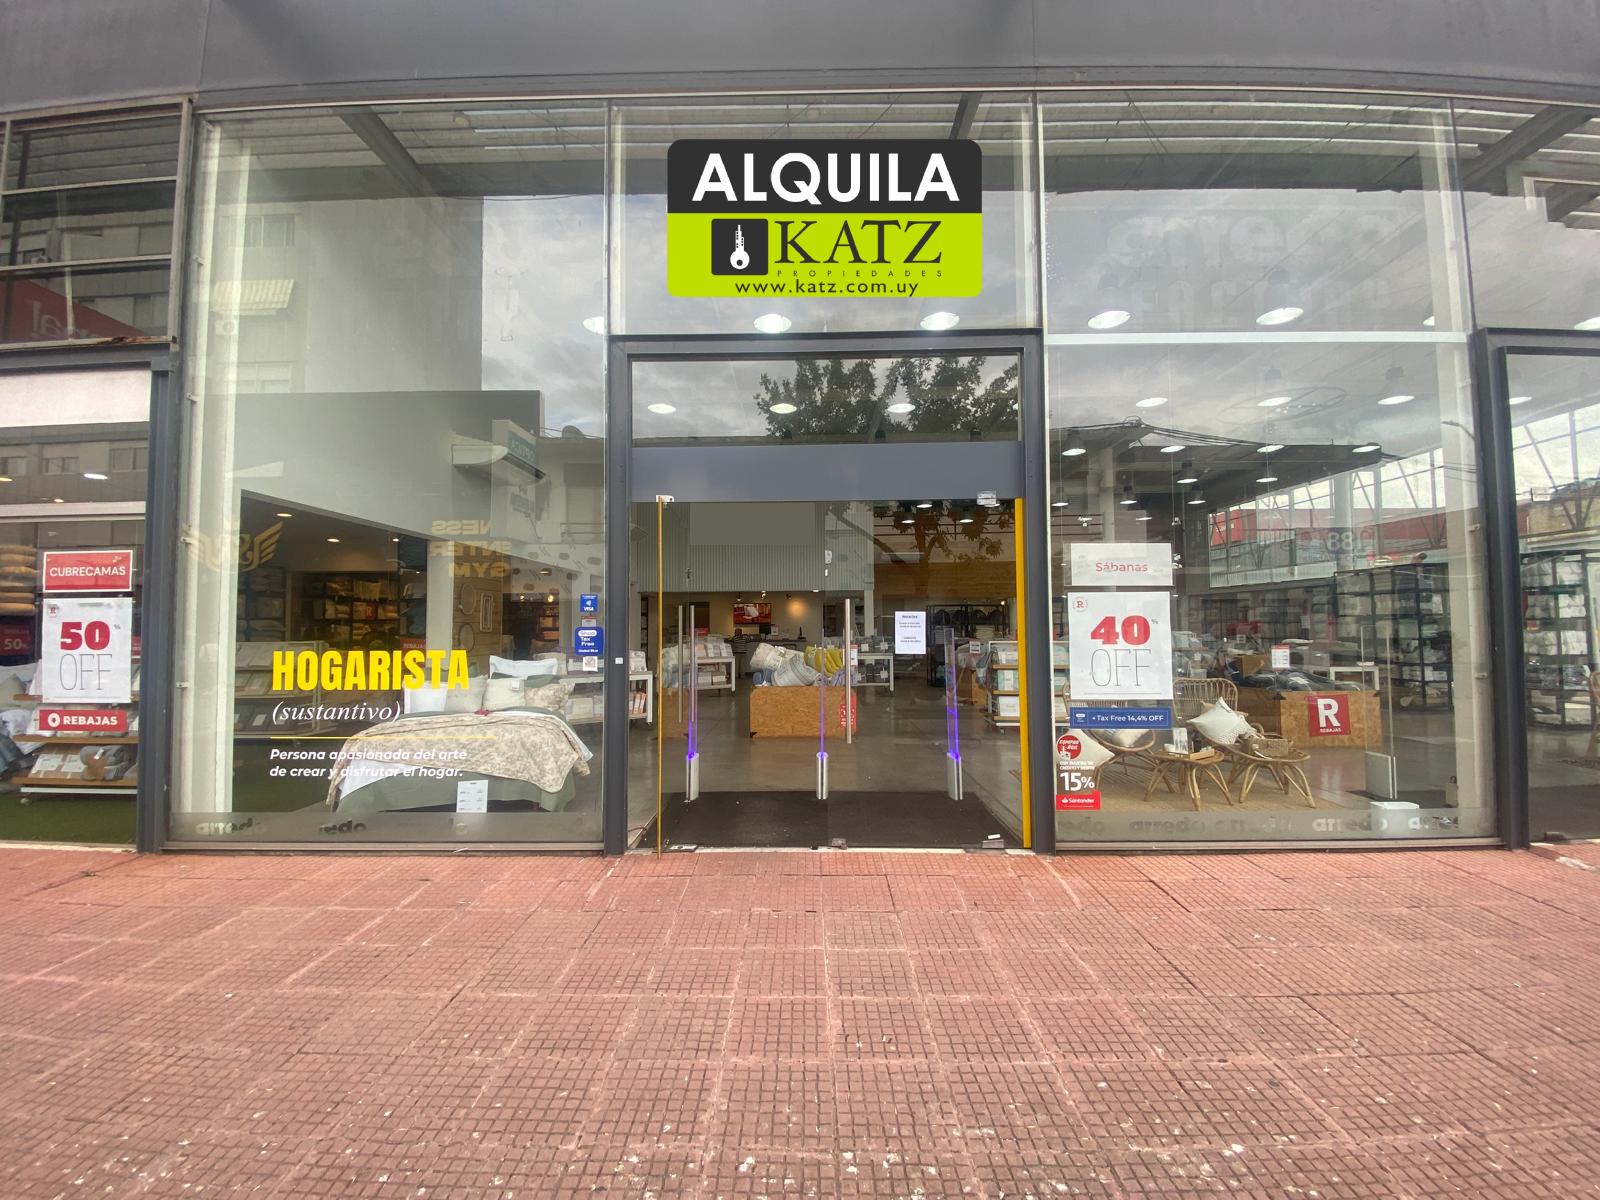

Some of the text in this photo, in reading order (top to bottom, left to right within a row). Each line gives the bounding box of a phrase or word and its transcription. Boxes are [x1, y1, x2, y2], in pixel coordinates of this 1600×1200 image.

[50, 566, 126, 577] CUBRECAMAS
[1095, 562, 1148, 572] Sábanas
[59, 653, 113, 691] OFF
[272, 650, 470, 691] HOGARISTA
[1091, 648, 1152, 687] OFF
[63, 715, 118, 726] REBAJAS
[272, 701, 401, 725] (sustantivo)
[1317, 698, 1341, 727] R
[270, 749, 467, 763] Persona apasionada del arte
[270, 765, 464, 780] de crear y disfrutar el hogar.
[1060, 771, 1095, 791] 15%
